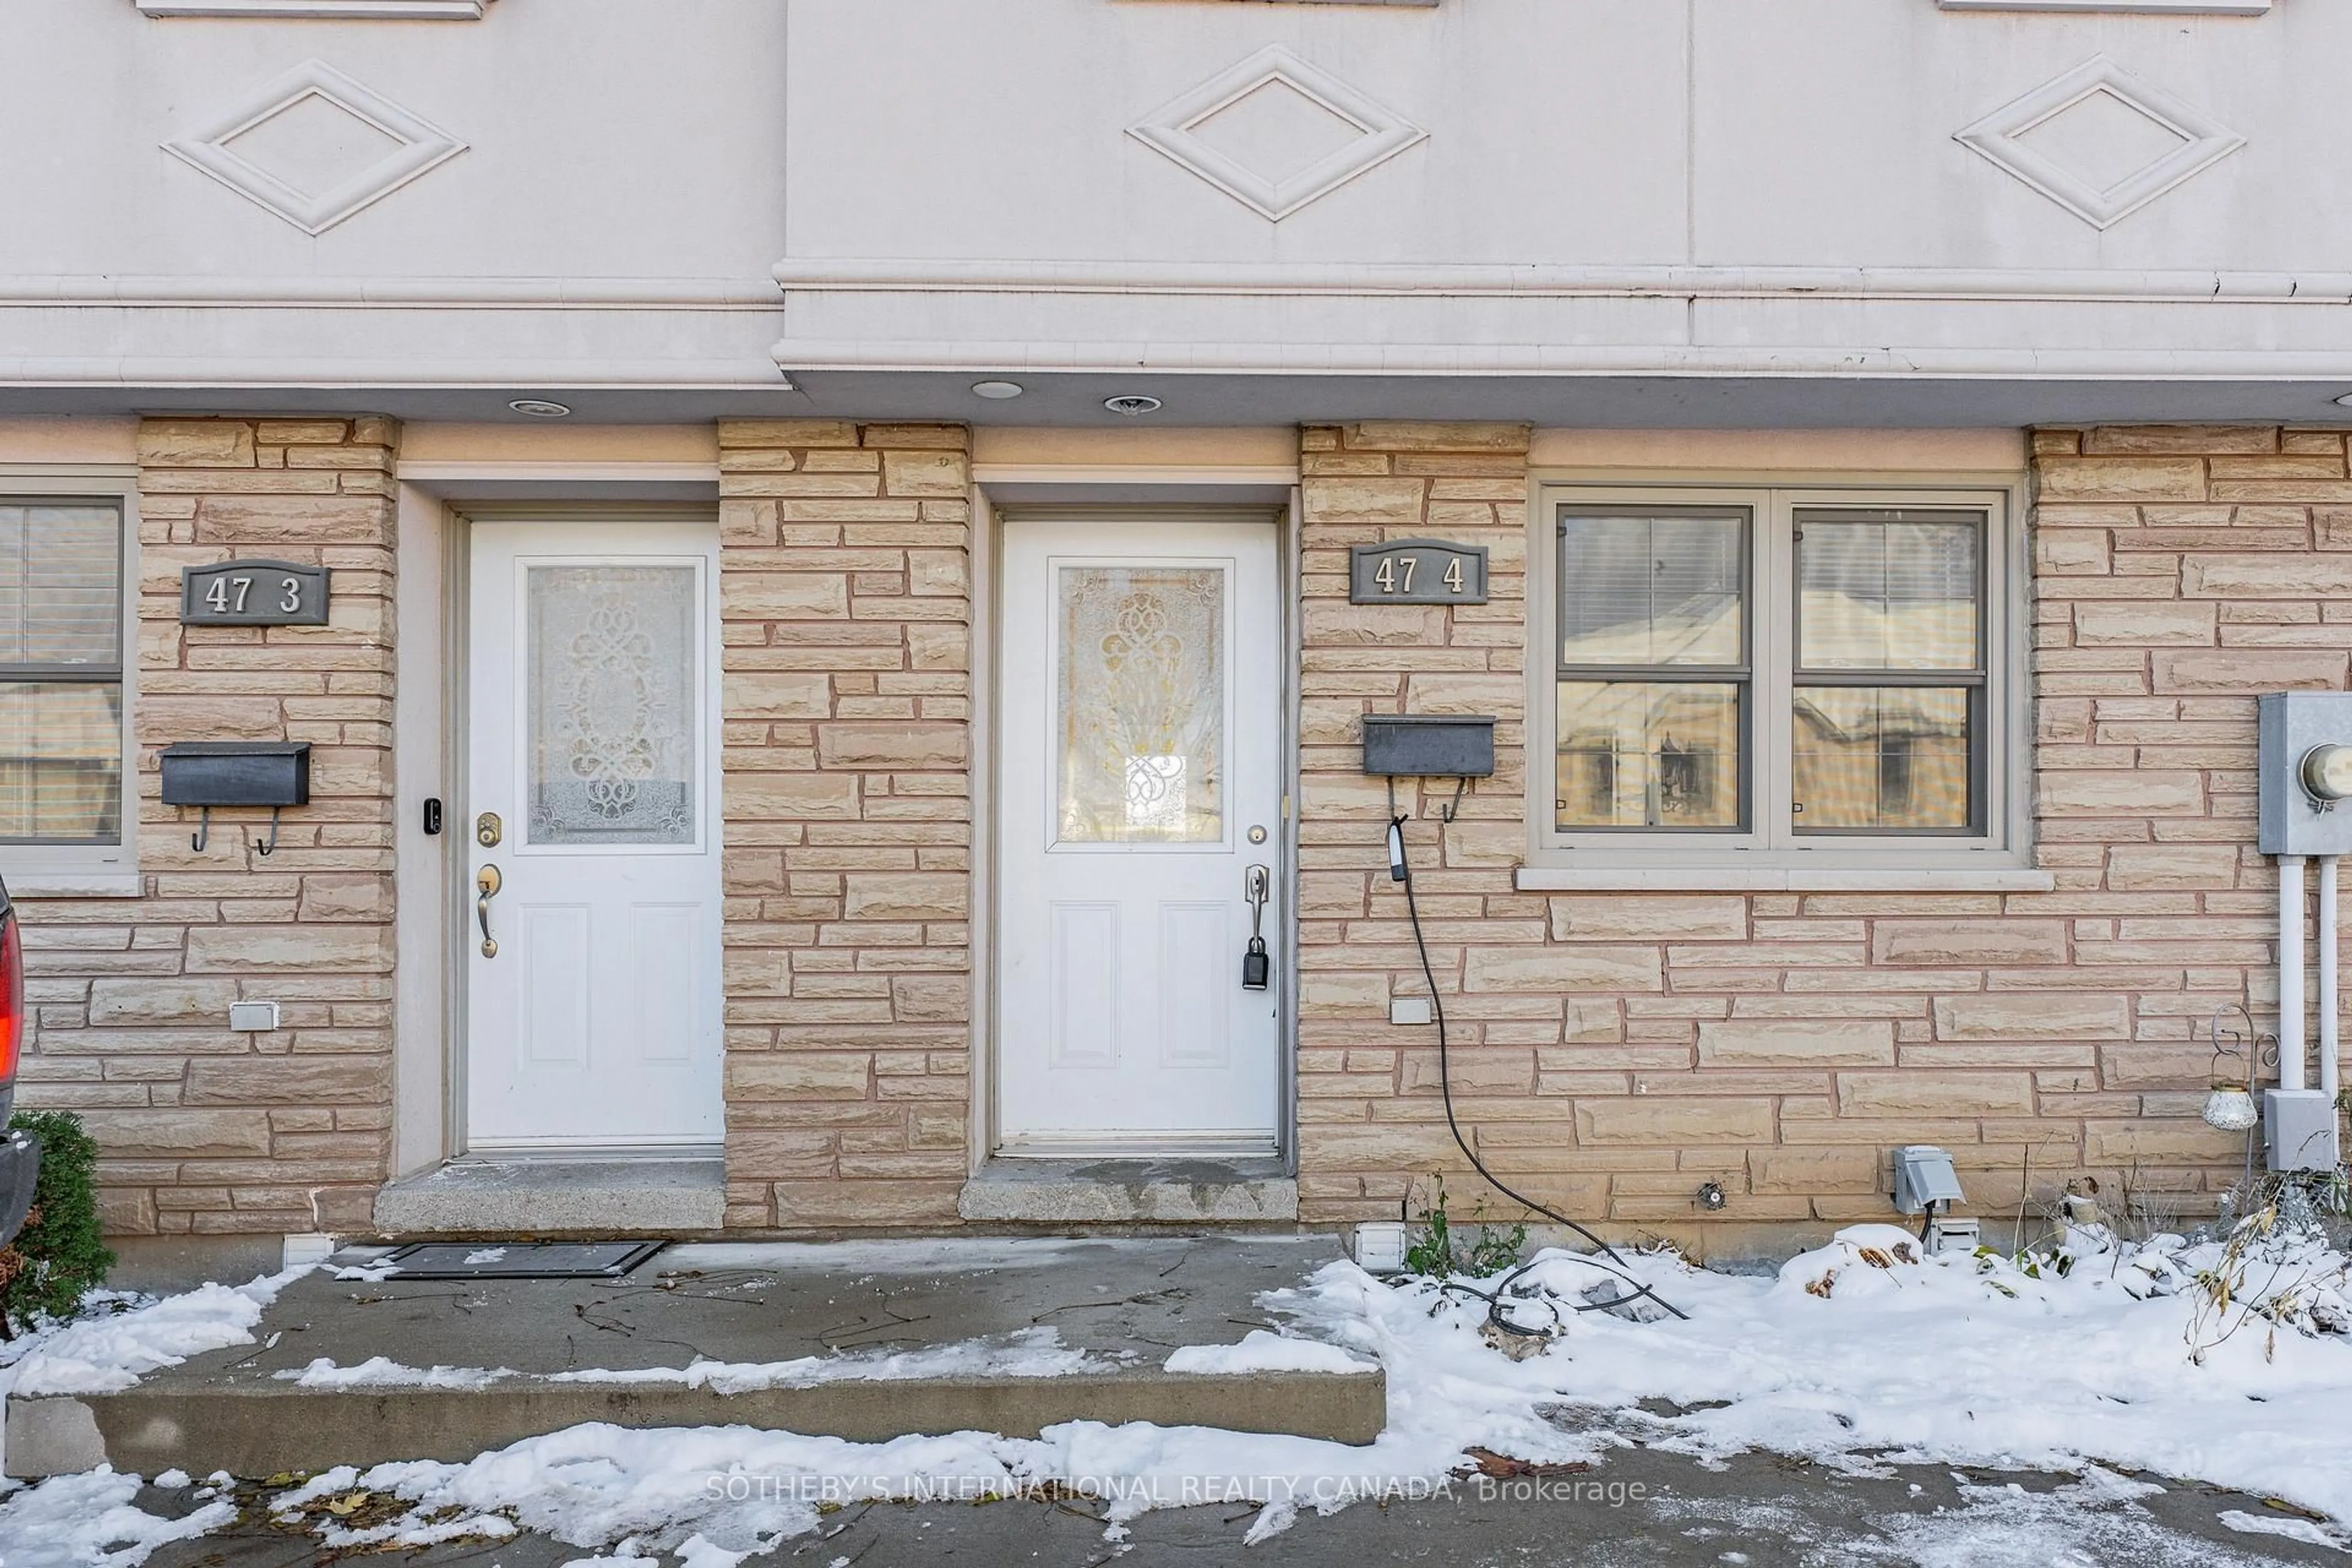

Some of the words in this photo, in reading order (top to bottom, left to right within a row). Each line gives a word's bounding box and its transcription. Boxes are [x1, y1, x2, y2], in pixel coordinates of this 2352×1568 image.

[1374, 557, 1418, 593] 47
[1443, 557, 1463, 594] 4
[205, 577, 253, 612] 47
[280, 578, 301, 613] 3
